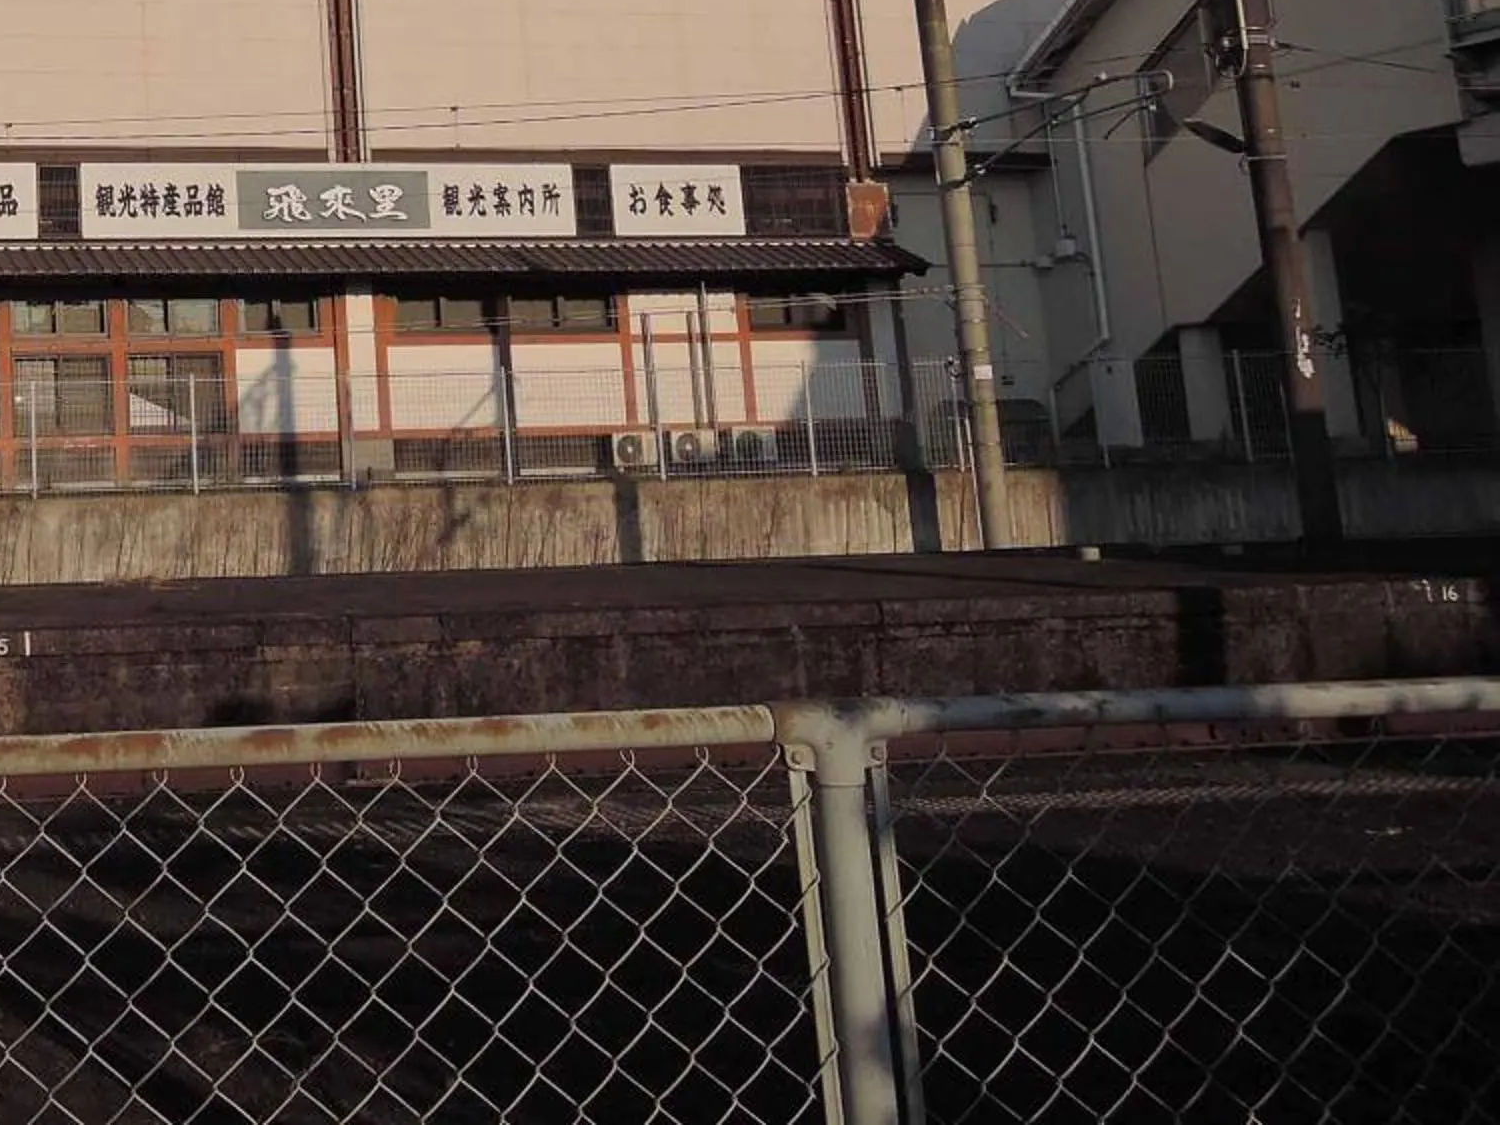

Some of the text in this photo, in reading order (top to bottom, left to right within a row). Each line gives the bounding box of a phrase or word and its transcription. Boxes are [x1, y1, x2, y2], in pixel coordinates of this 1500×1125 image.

[95, 182, 225, 218] 観光特産品館
[443, 182, 561, 216] 観光案内所
[629, 181, 726, 216] お食事処
[1442, 585, 1458, 602] 16
